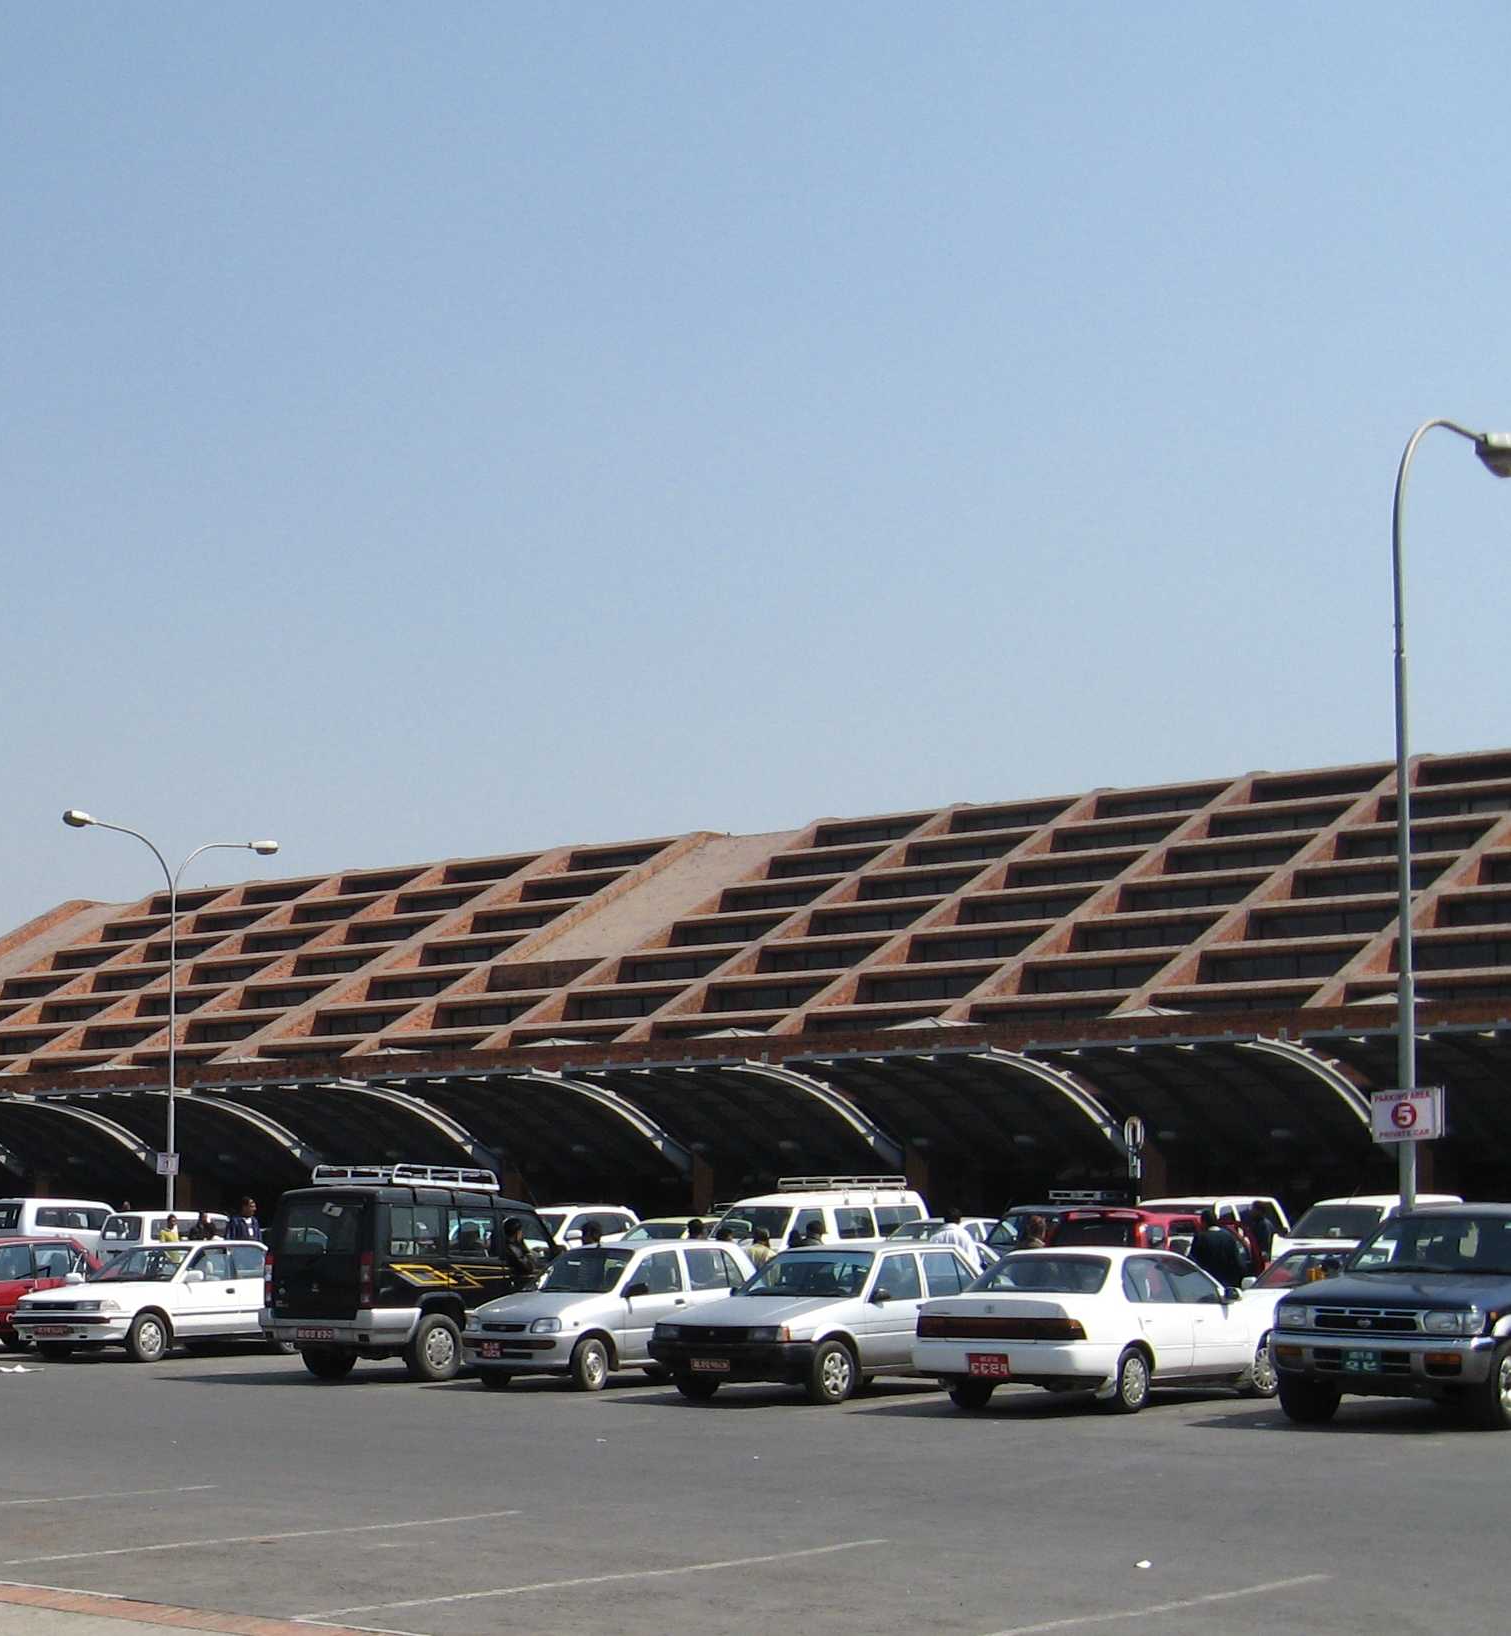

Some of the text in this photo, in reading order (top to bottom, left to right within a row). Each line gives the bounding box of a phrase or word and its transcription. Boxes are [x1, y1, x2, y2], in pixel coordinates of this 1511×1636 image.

[1373, 1090, 1431, 1103] PARKING AREA
[1397, 1105, 1412, 1126] 5
[1379, 1128, 1430, 1138] PRIVATE CAR
